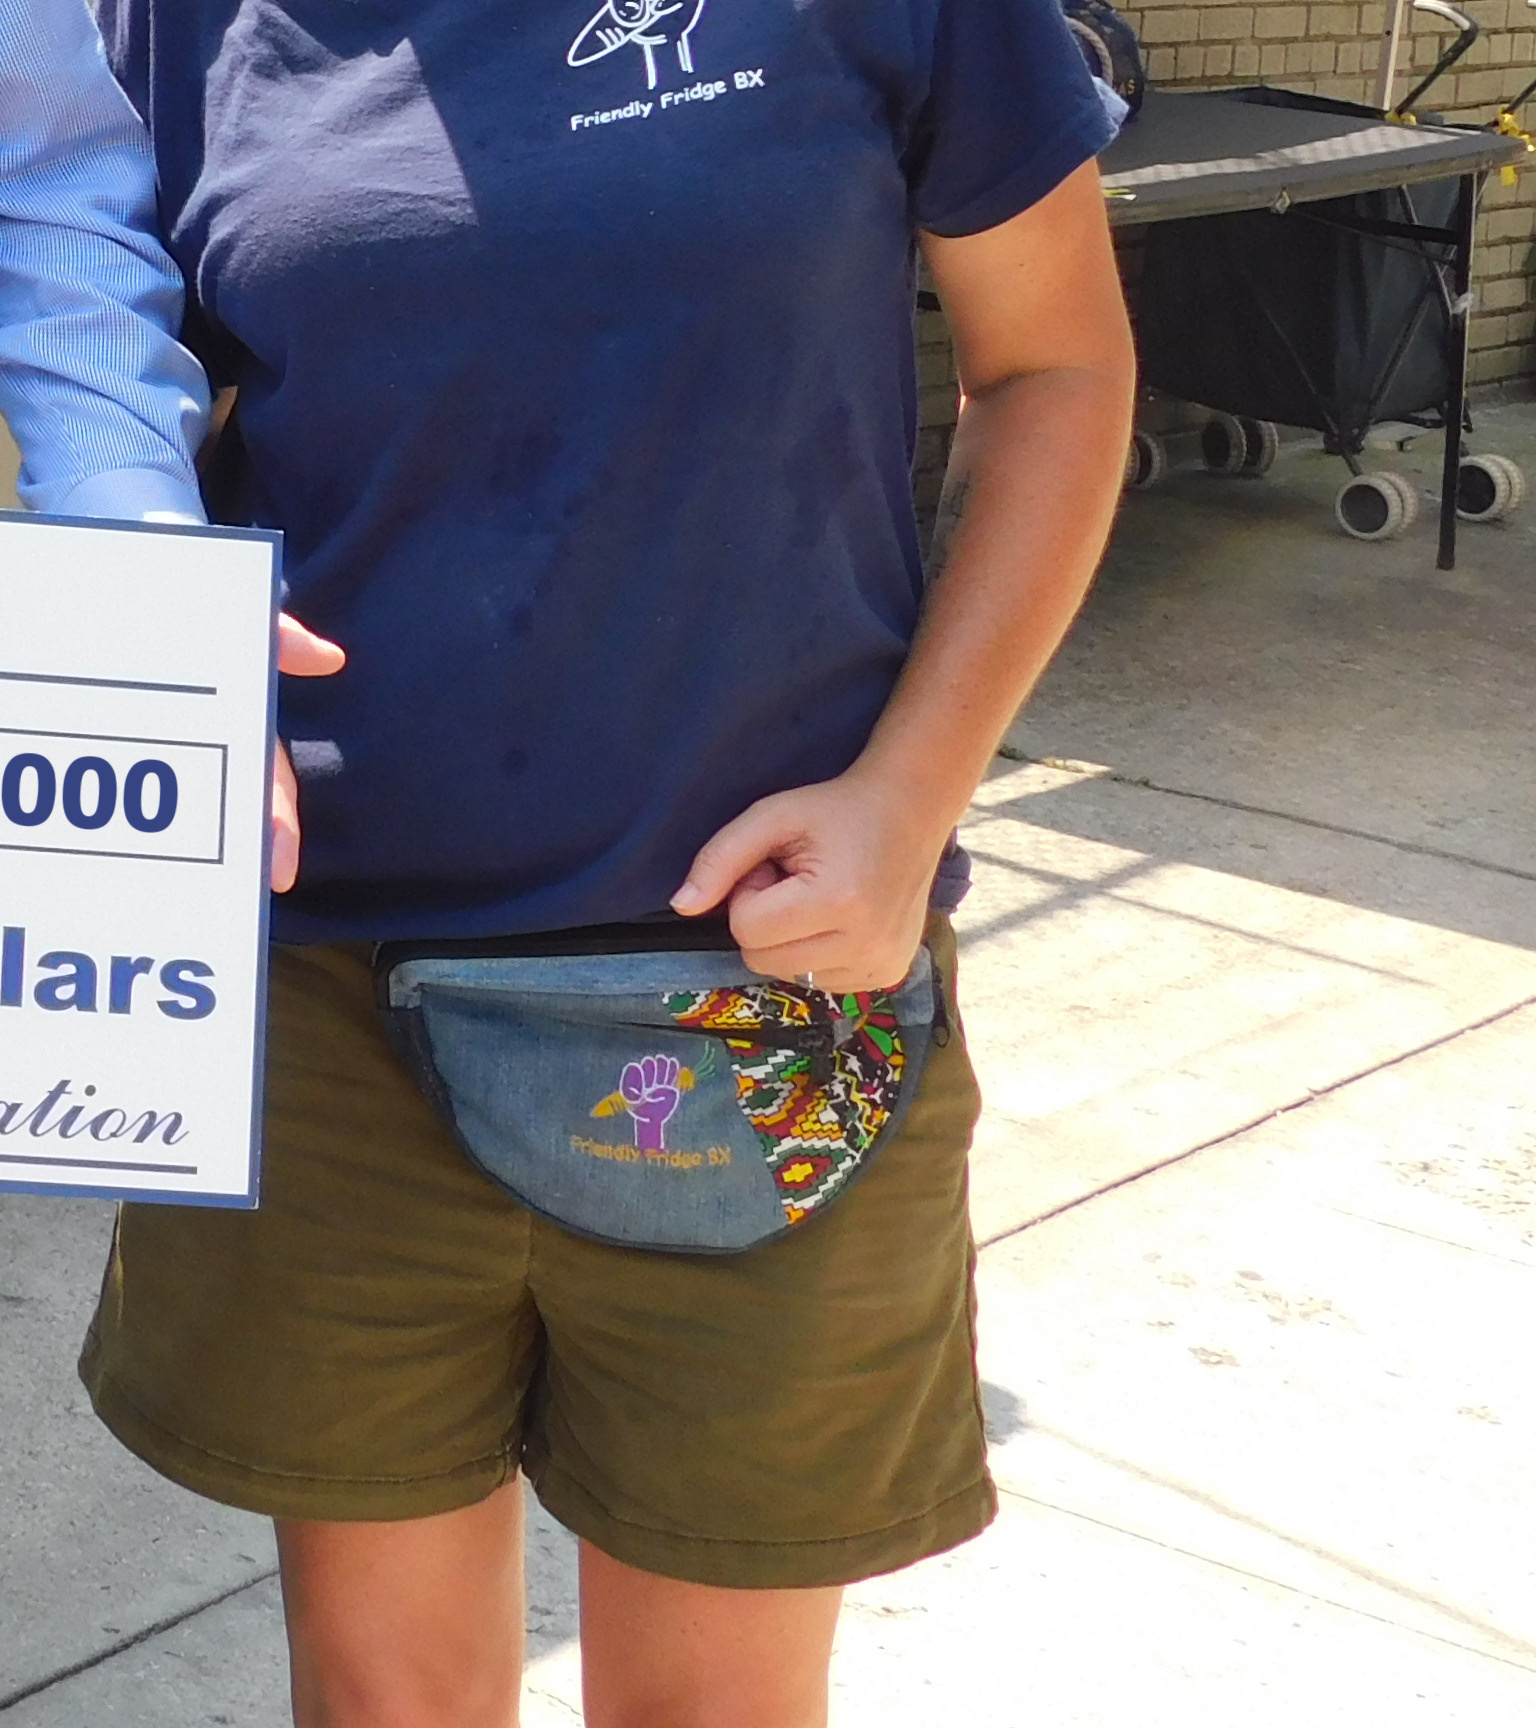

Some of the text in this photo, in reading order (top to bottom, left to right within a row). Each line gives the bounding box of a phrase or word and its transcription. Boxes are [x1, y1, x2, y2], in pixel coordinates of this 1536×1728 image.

[571, 68, 765, 132] Friendly Fridge BX
[570, 1135, 732, 1170] Friendly Fridge BX
